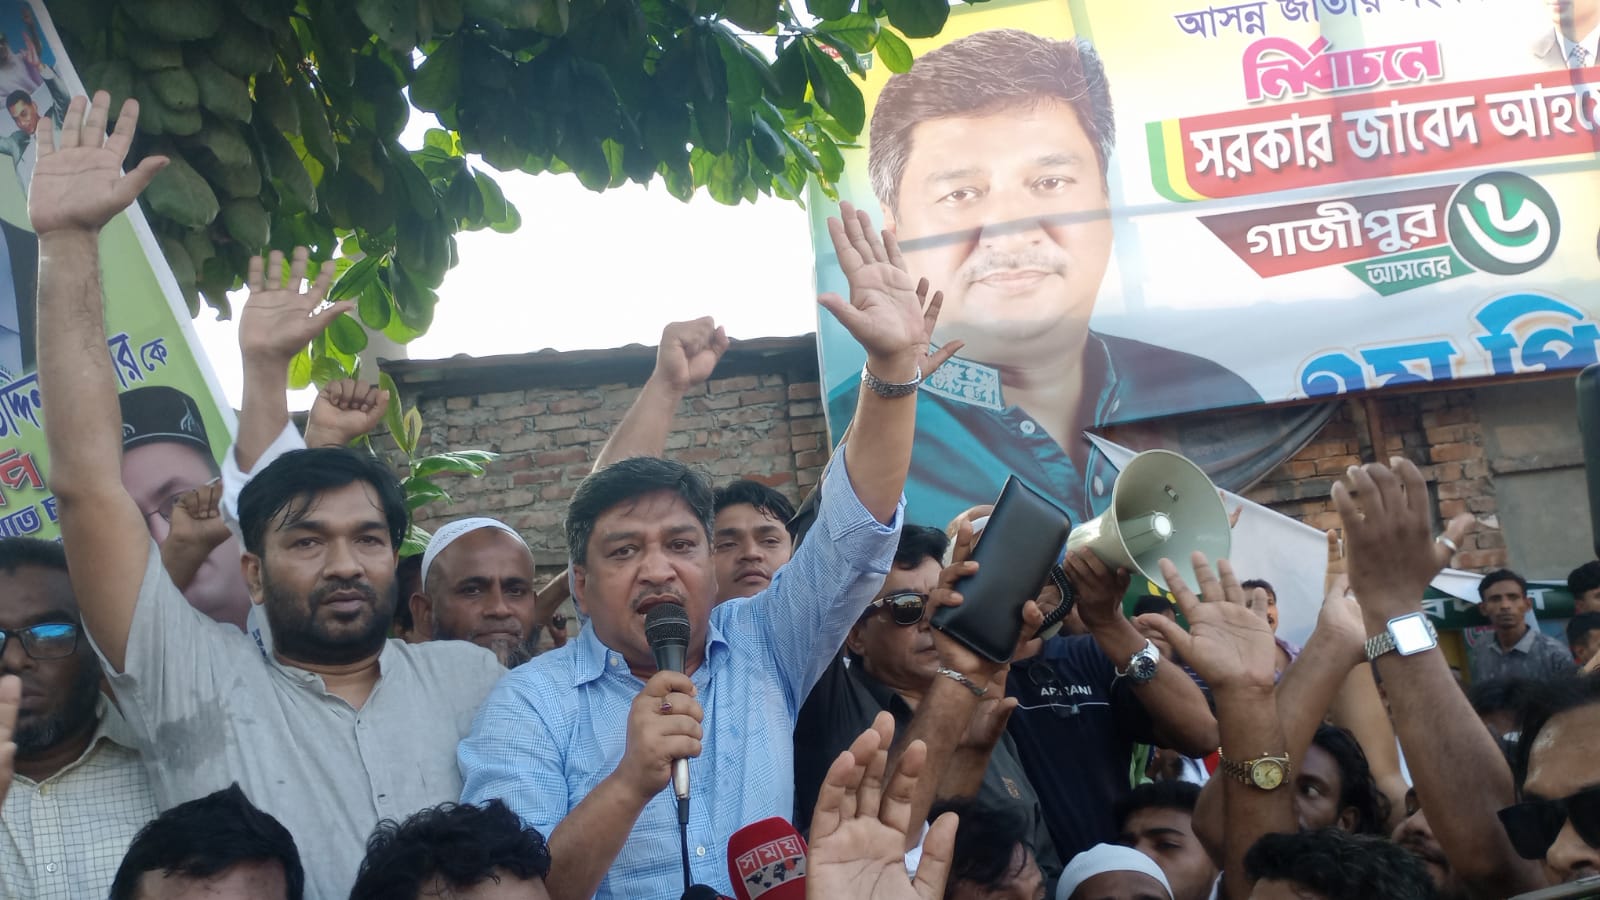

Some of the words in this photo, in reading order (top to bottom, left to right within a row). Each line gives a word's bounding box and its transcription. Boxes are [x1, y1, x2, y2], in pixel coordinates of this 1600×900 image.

[1175, 2, 1267, 39] আসন্ন
[1243, 35, 1443, 101] নির্বাচনে
[1190, 113, 1334, 179] সরকার
[1343, 96, 1479, 159] জাবেদ
[1246, 200, 1439, 254] গাজীপুর
[1457, 182, 1552, 264] ৬
[1365, 254, 1453, 286] আসনের
[737, 836, 801, 874] সময়
